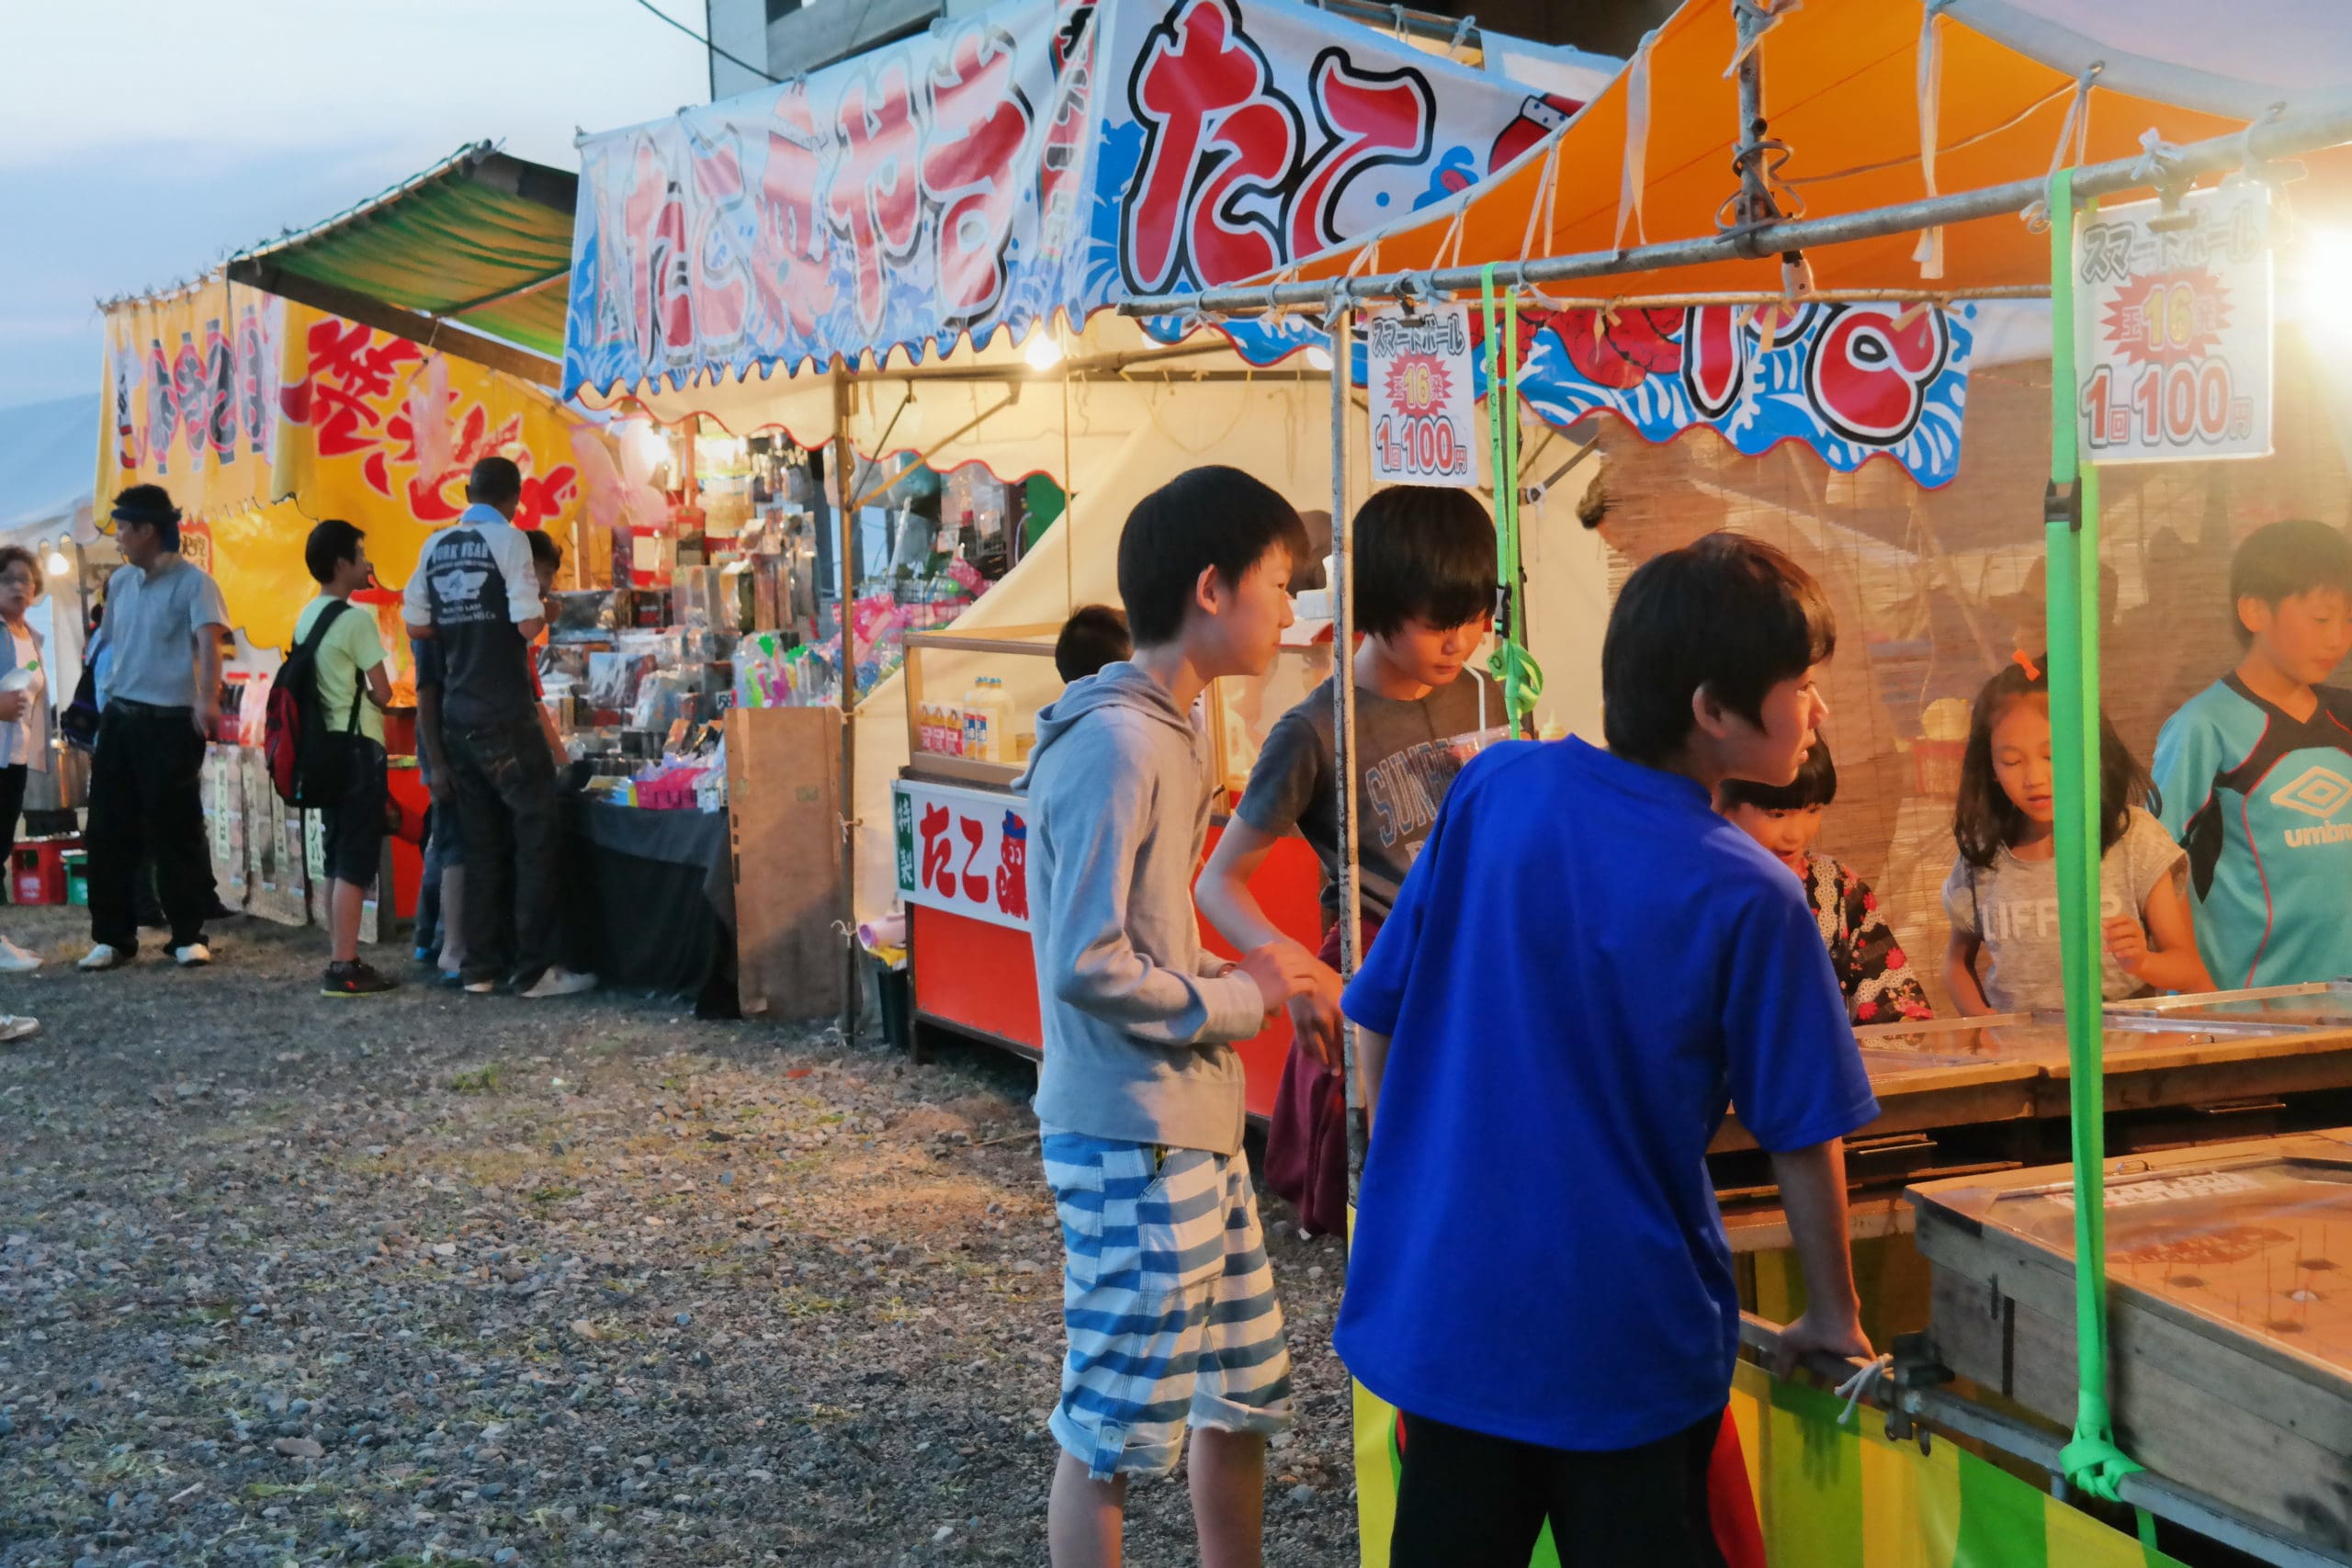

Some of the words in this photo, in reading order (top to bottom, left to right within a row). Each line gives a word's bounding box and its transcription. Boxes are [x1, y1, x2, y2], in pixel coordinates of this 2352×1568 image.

[1373, 313, 1465, 357] スマートボール
[898, 797, 913, 884] 特製
[920, 801, 989, 904] たこ
